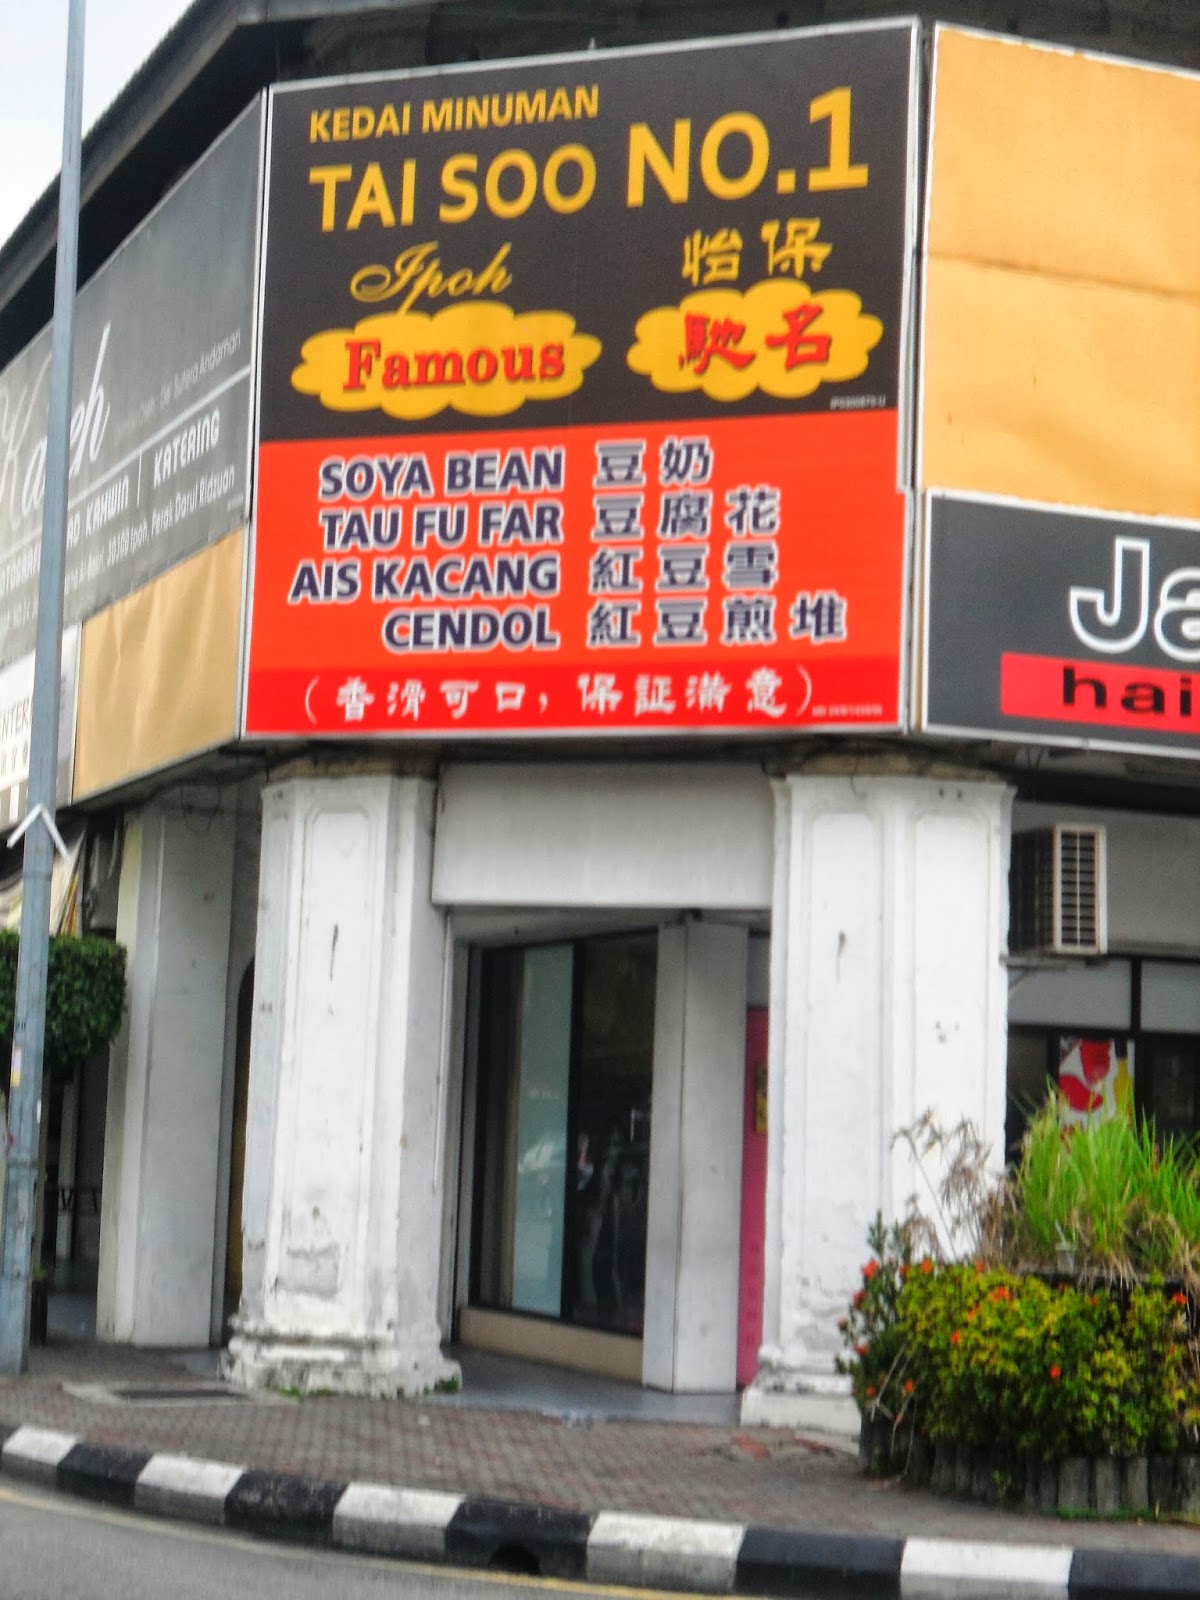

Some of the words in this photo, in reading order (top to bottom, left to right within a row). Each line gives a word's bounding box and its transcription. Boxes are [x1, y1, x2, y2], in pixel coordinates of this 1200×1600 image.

[310, 104, 410, 143] KEDAI
[422, 86, 599, 133] MINUMAN
[309, 160, 415, 232] TAI
[439, 144, 597, 223] SOO
[626, 87, 869, 207] NO.1
[350, 242, 512, 309] Ipoh
[682, 217, 832, 286] 怡保
[343, 340, 565, 391] Famous
[679, 303, 833, 375] 馳名
[154, 408, 220, 490] KATERING
[320, 454, 434, 502] SOYA
[444, 448, 565, 495] BEAN
[593, 436, 713, 489] 豆奶
[319, 507, 400, 550] TAU
[411, 505, 467, 548] FU
[476, 499, 564, 545] FAR
[591, 486, 780, 542] 豆腐花
[287, 558, 360, 604] AIS
[369, 550, 560, 600] KACANG
[588, 540, 778, 595] 紅豆雪
[381, 605, 560, 654] CENDOL
[586, 591, 847, 648] 紅豆煎堆
